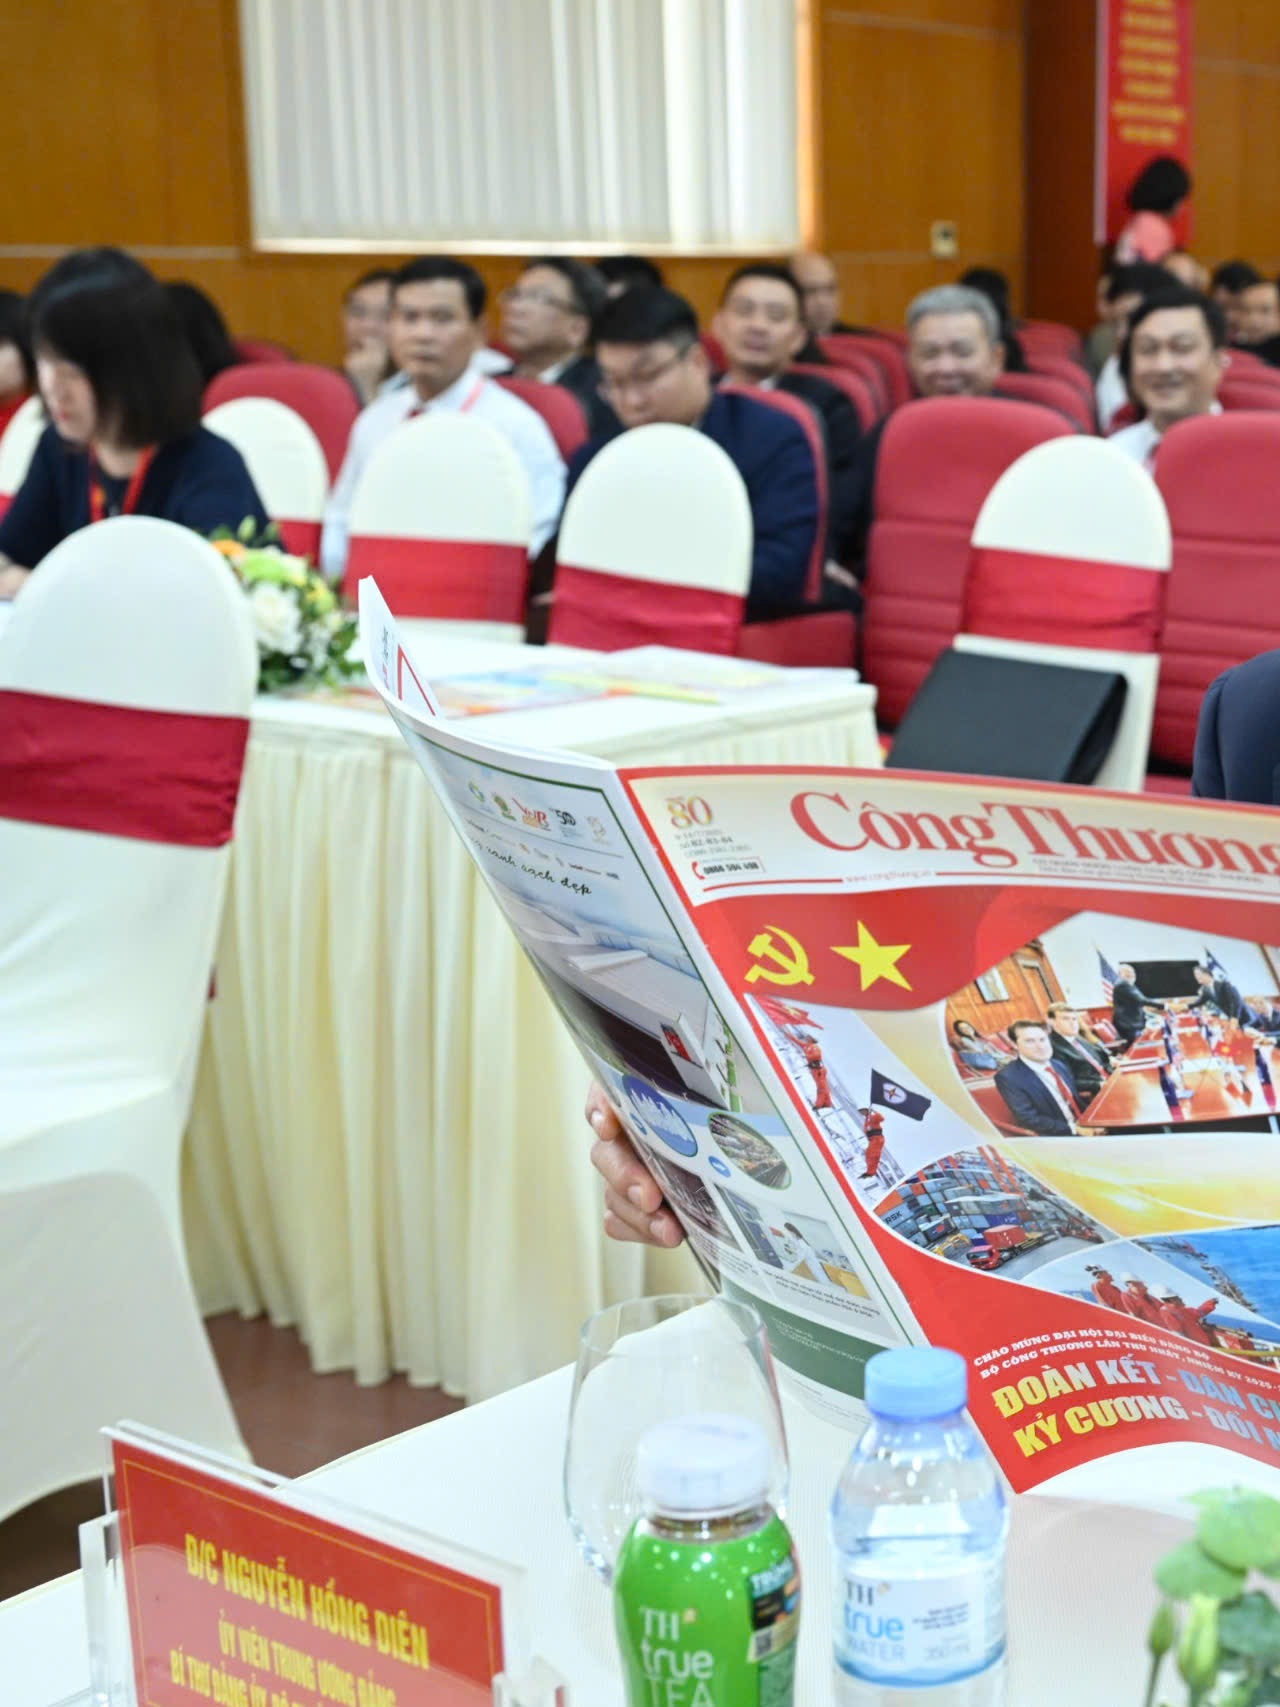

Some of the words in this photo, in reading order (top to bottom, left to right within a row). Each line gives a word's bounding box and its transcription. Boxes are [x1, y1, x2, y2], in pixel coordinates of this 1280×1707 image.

[1001, 1350, 1039, 1369] CÔNG
[991, 1362, 1097, 1418] ĐOÀN
[1096, 1353, 1162, 1386] KẾT
[1064, 1395, 1190, 1435] CƯƠNG
[843, 1600, 905, 1642] true
[641, 1639, 715, 1680] true
